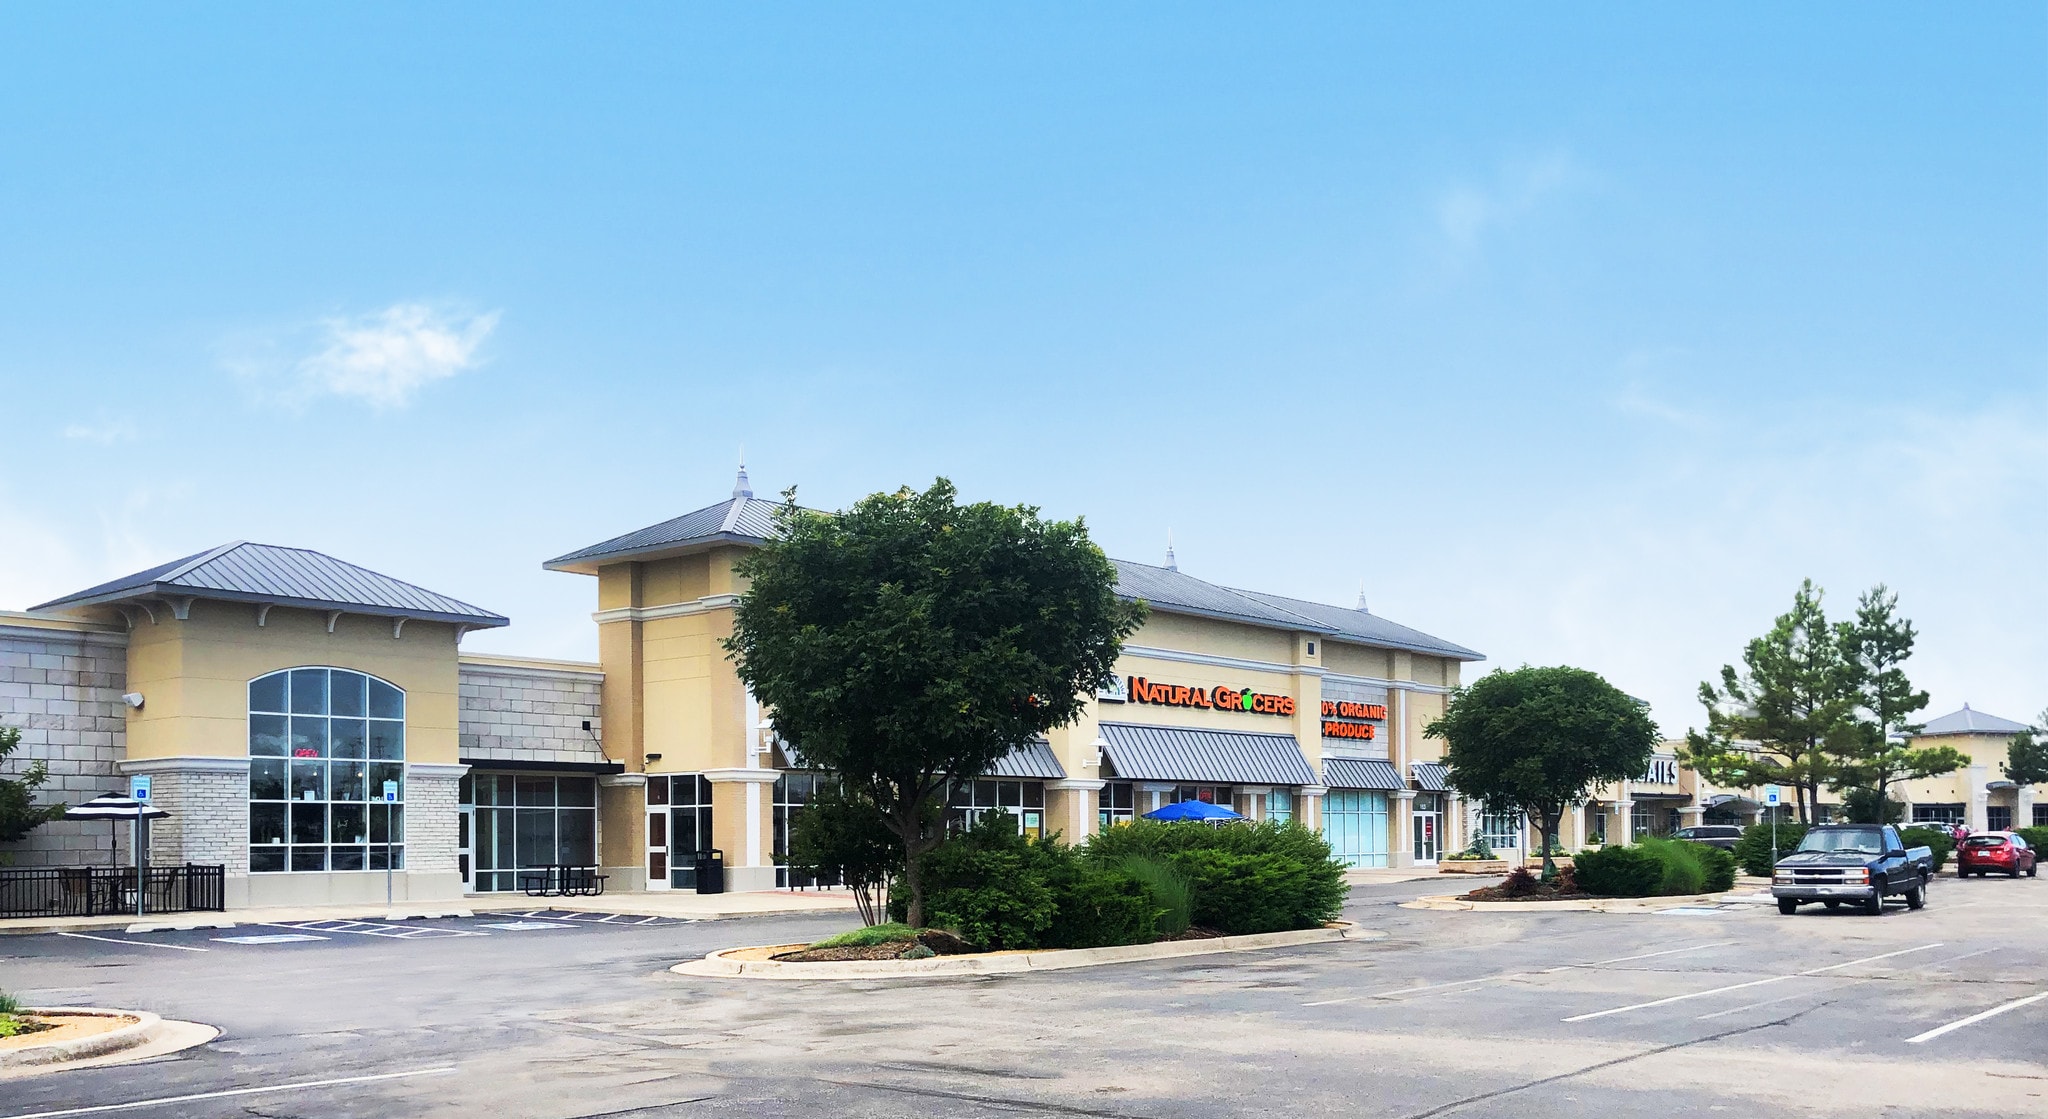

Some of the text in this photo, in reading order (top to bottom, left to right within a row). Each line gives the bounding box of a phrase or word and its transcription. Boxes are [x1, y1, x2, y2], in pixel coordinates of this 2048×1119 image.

[1130, 676, 1213, 708] NATURAL
[1321, 701, 1388, 720] 0% ORGANIC
[1324, 721, 1376, 739] PRODUCE
[1638, 760, 1679, 785] AILS
